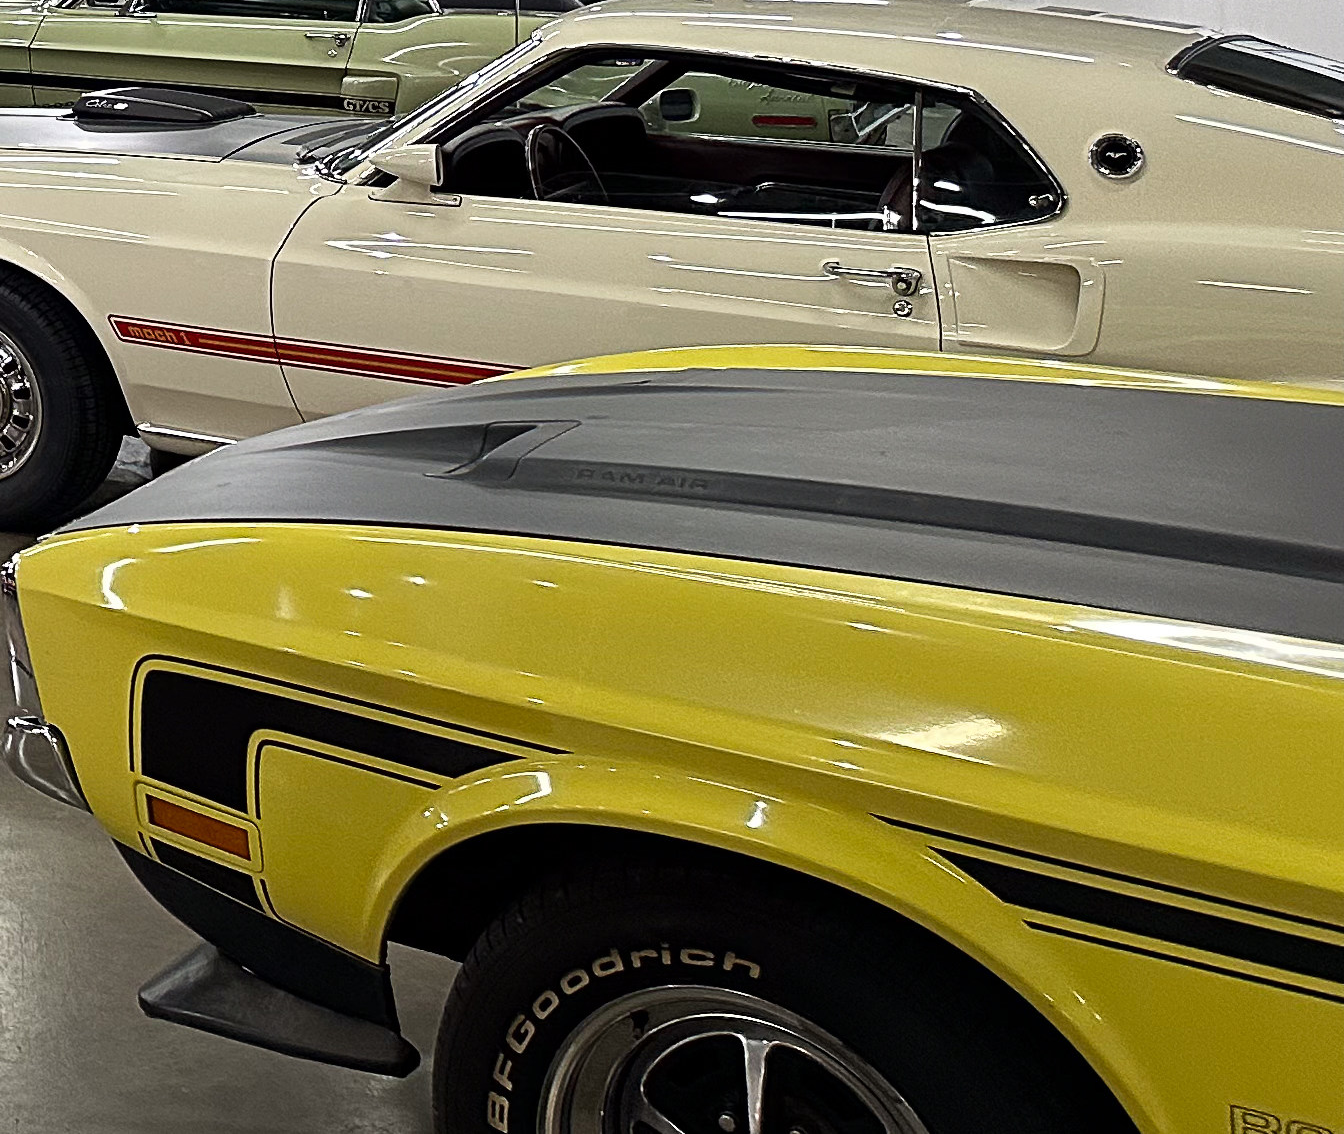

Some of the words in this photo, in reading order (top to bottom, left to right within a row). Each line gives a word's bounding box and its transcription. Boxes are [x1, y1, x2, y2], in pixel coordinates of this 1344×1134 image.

[343, 98, 390, 114] GT/CS
[127, 325, 179, 344] mach
[180, 331, 192, 345] 1
[486, 942, 762, 1134] BFGoodrich
